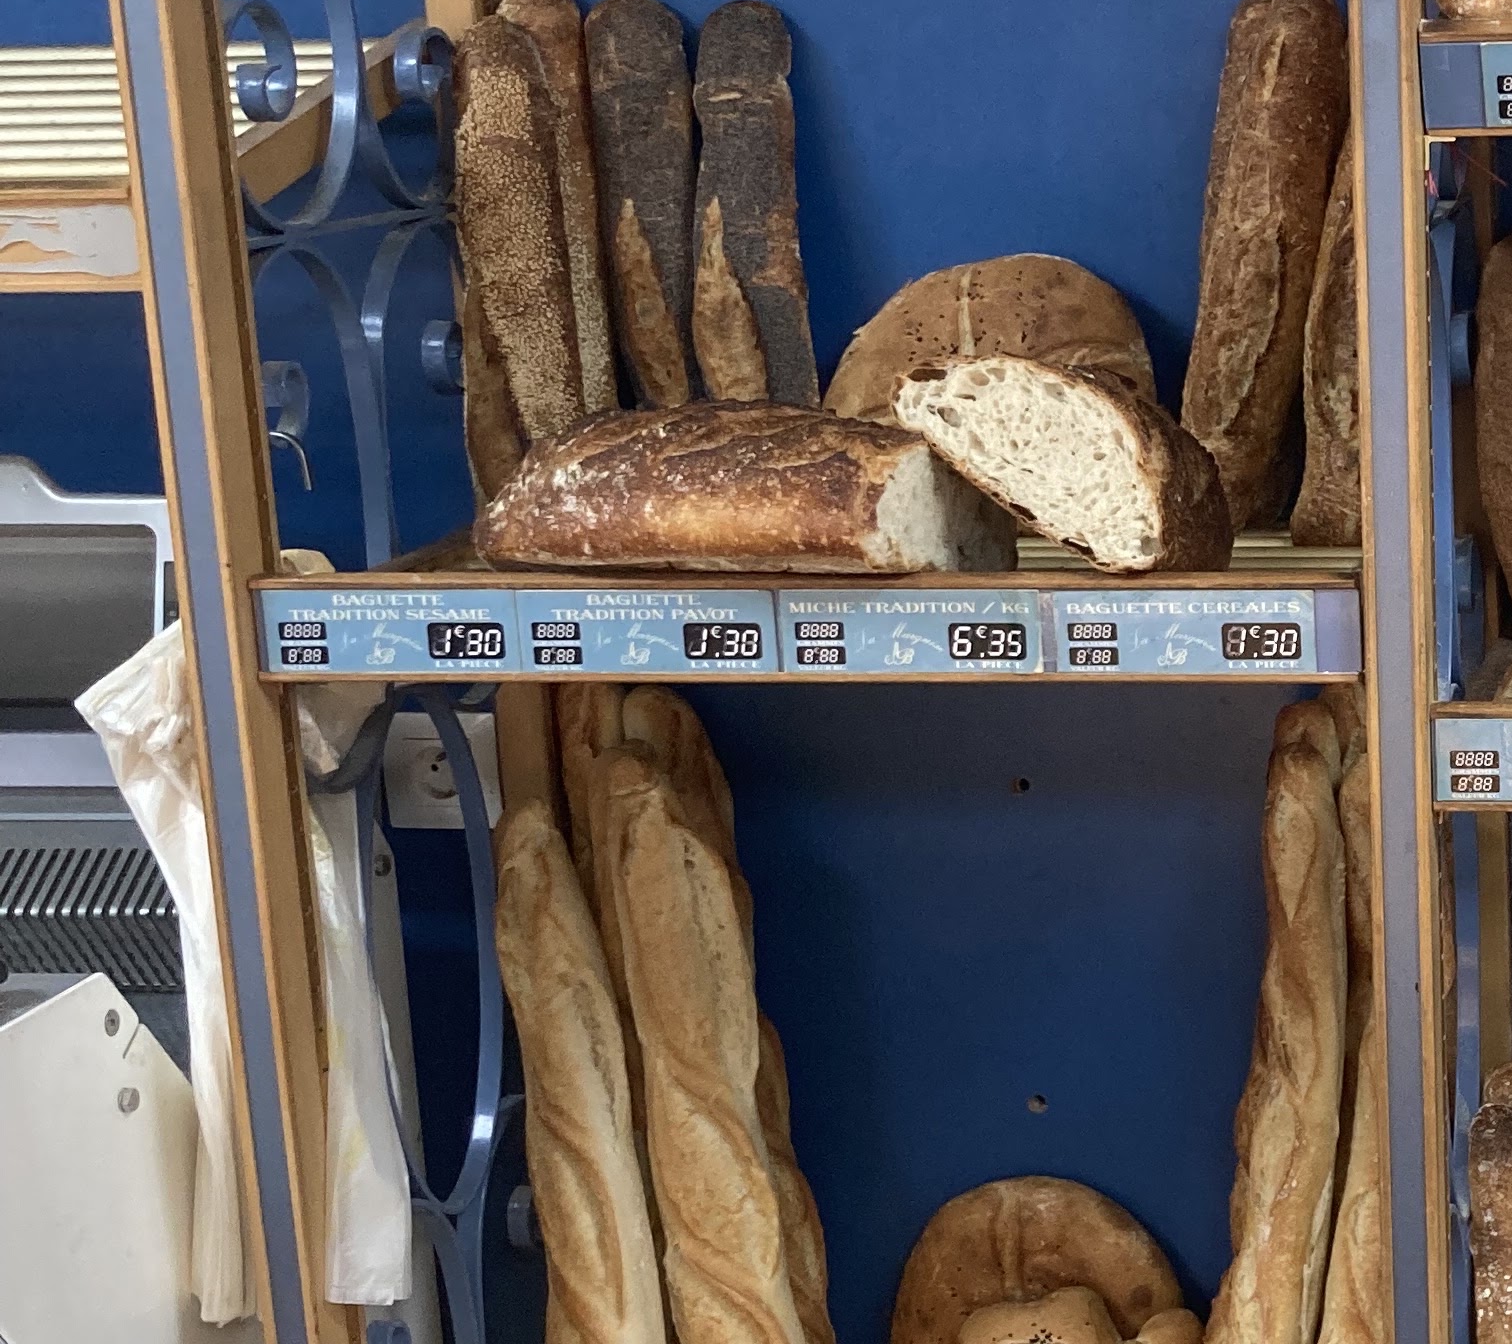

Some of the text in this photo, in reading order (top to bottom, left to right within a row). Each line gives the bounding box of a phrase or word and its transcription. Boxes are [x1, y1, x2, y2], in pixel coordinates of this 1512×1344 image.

[333, 595, 444, 606] BAGUETTE
[587, 595, 700, 606] BAGUETTE
[789, 602, 856, 613] MICHE
[864, 602, 975, 613] TRADITION
[1002, 602, 1029, 613] KG
[1067, 602, 1300, 614] BAGUETTE CEREALES
[289, 609, 491, 620] TRADITION SESAME
[551, 609, 738, 620] TRADITION PAVOT
